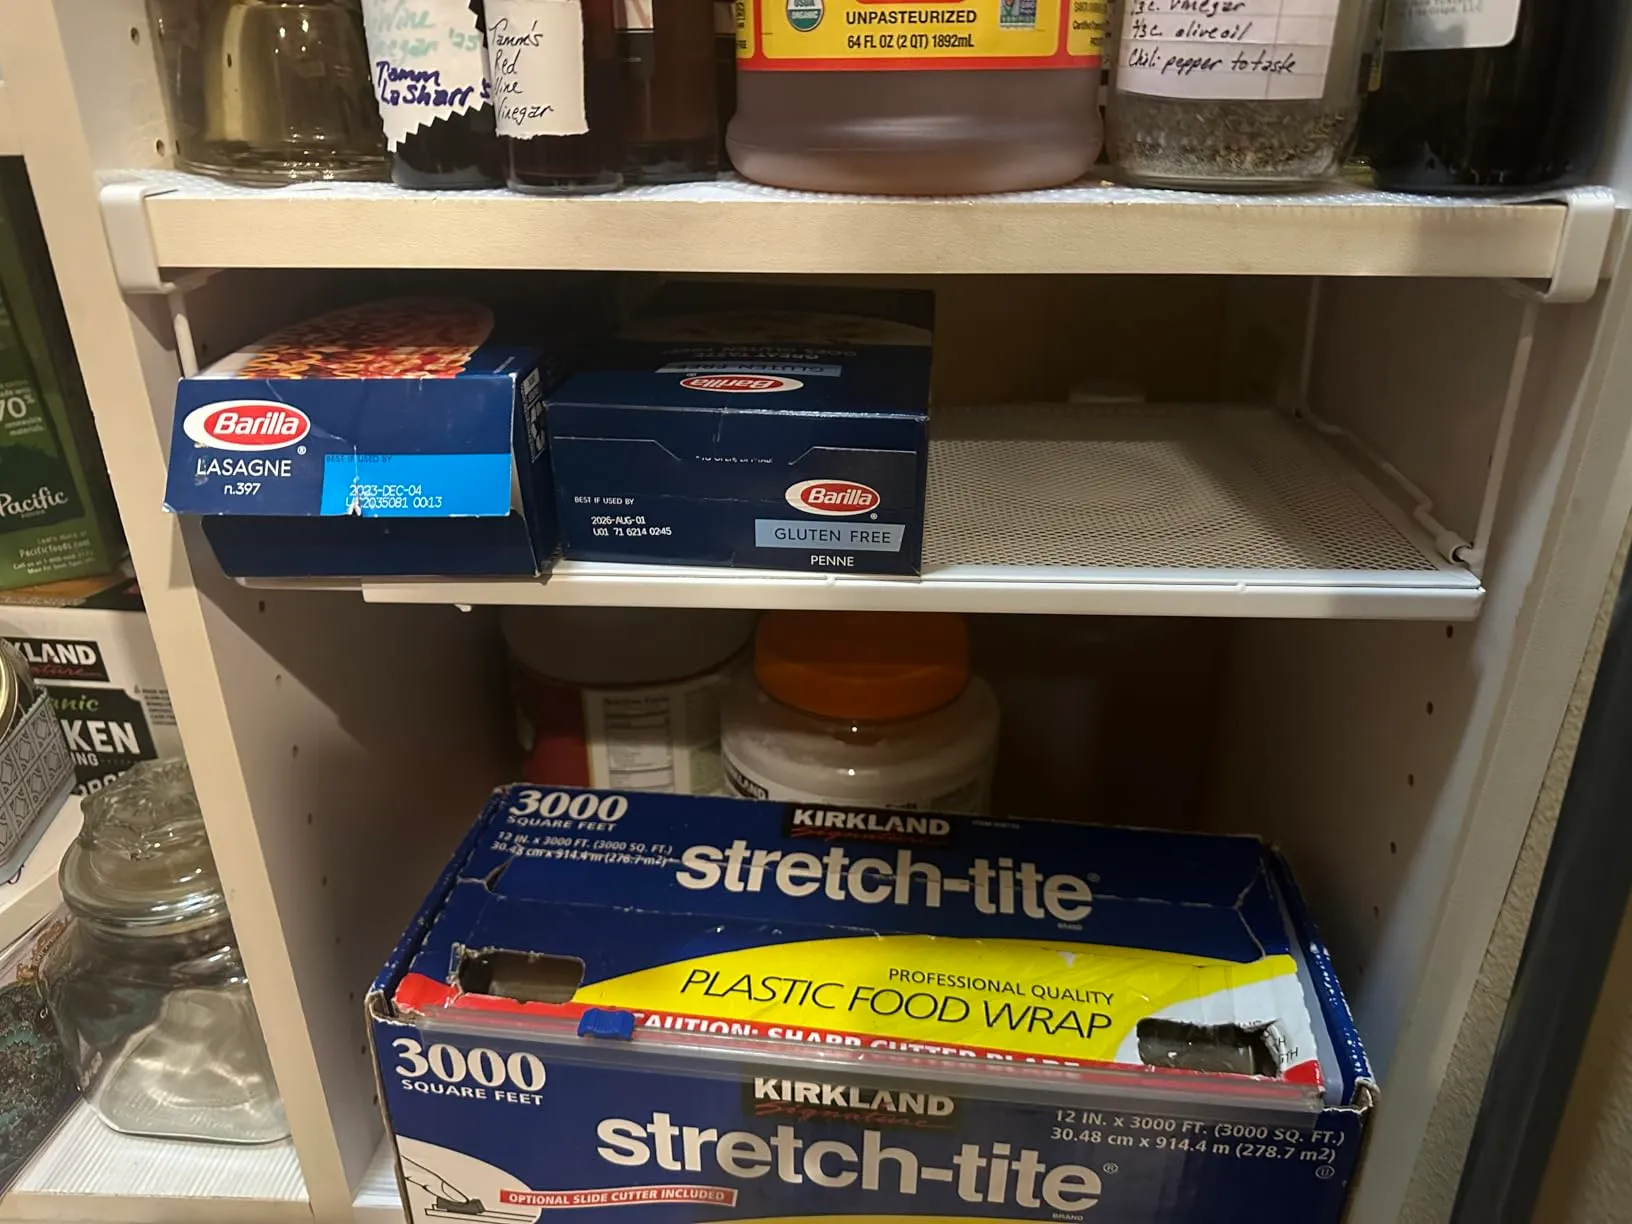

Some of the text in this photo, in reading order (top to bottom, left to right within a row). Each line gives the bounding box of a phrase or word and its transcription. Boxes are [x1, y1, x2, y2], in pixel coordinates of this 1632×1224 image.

[846, 10, 977, 25] UNPASTEURIZED
[847, 33, 975, 50] 64 FL OZ (2 QT) 1892mL
[1161, 56, 1223, 76] pepper
[737, 363, 825, 373] GLUTEN
[690, 378, 775, 390] Barilla
[213, 411, 301, 437] Barilla
[196, 458, 292, 477] LASAGNE
[223, 482, 261, 496] n.397
[806, 487, 874, 508] Barilla
[0, 486, 69, 517] Pacific
[594, 496, 601, 504] IF
[602, 497, 623, 505] USED
[591, 516, 646, 525] 2026-AUG-01
[648, 526, 673, 536] 0245
[774, 528, 892, 544] GLUTEN FREE
[810, 554, 855, 568] PENNE
[509, 789, 629, 822] 3000
[506, 814, 618, 832] SQUARE FEET
[792, 808, 951, 836] KIRKLAND
[543, 836, 572, 847] 3000
[573, 837, 590, 848] FT.
[593, 839, 627, 851] (3000
[630, 841, 648, 853] SQ.
[676, 839, 1093, 922] stretch-tite
[888, 967, 1115, 1007] PROFESSIONAL QUALITY
[680, 968, 1114, 1041] PLASTIC FOOD WRAP
[391, 1037, 546, 1093] 3000
[401, 1079, 543, 1106] SQUARE FEET
[753, 1076, 955, 1117] KIRKLAND
[1055, 1109, 1345, 1147] 12 IN. x 3000 FT. (3000 SQ. FT.)
[1050, 1127, 1336, 1164] 30.48 cm x 914.4 m (278.7 m2)
[597, 1111, 1103, 1212] stretch-tite
[508, 1187, 725, 1206] OPTIONAL SLIDE CUTTER INCLUDED
